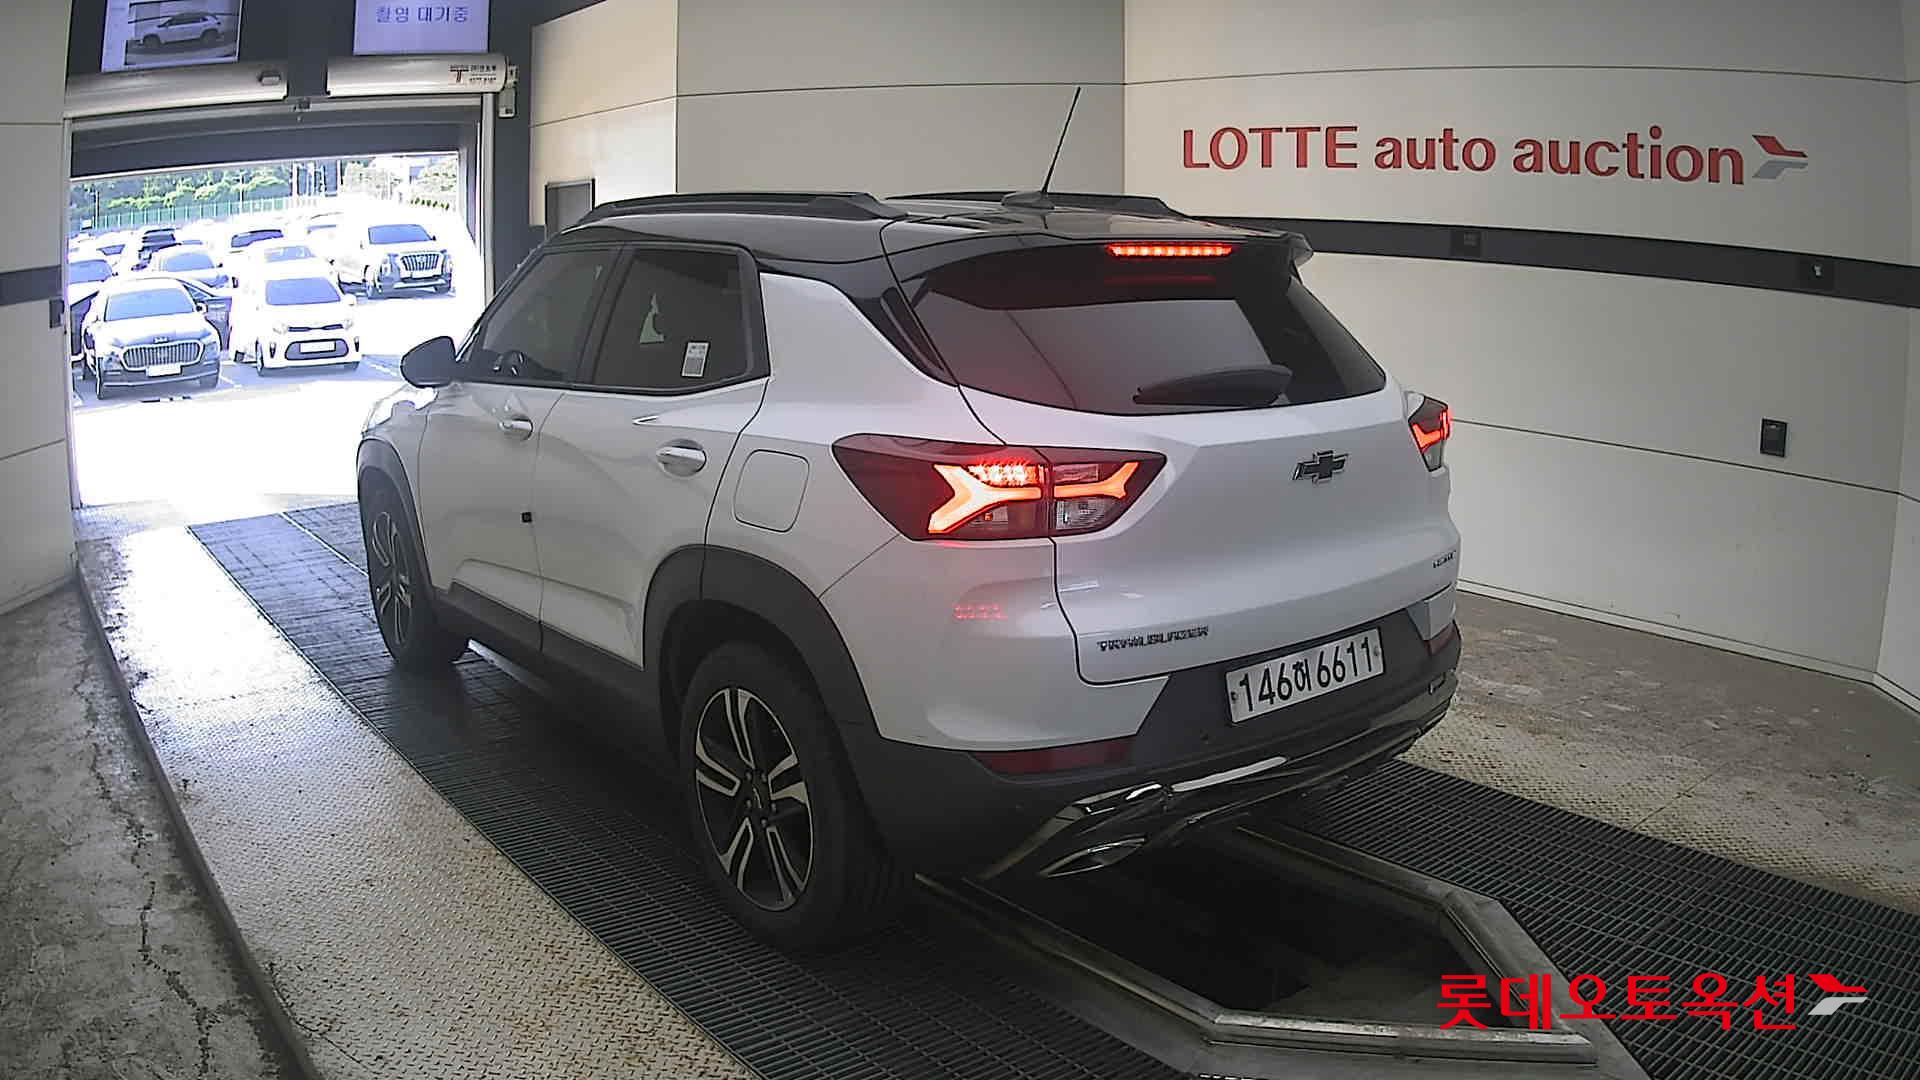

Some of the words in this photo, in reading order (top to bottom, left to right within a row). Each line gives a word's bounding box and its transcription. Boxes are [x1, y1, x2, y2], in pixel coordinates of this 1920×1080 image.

[417, 7, 469, 23] 대기중
[1183, 126, 1358, 169] LOTTE
[1374, 128, 1496, 172] auto
[1513, 126, 1744, 185] auction
